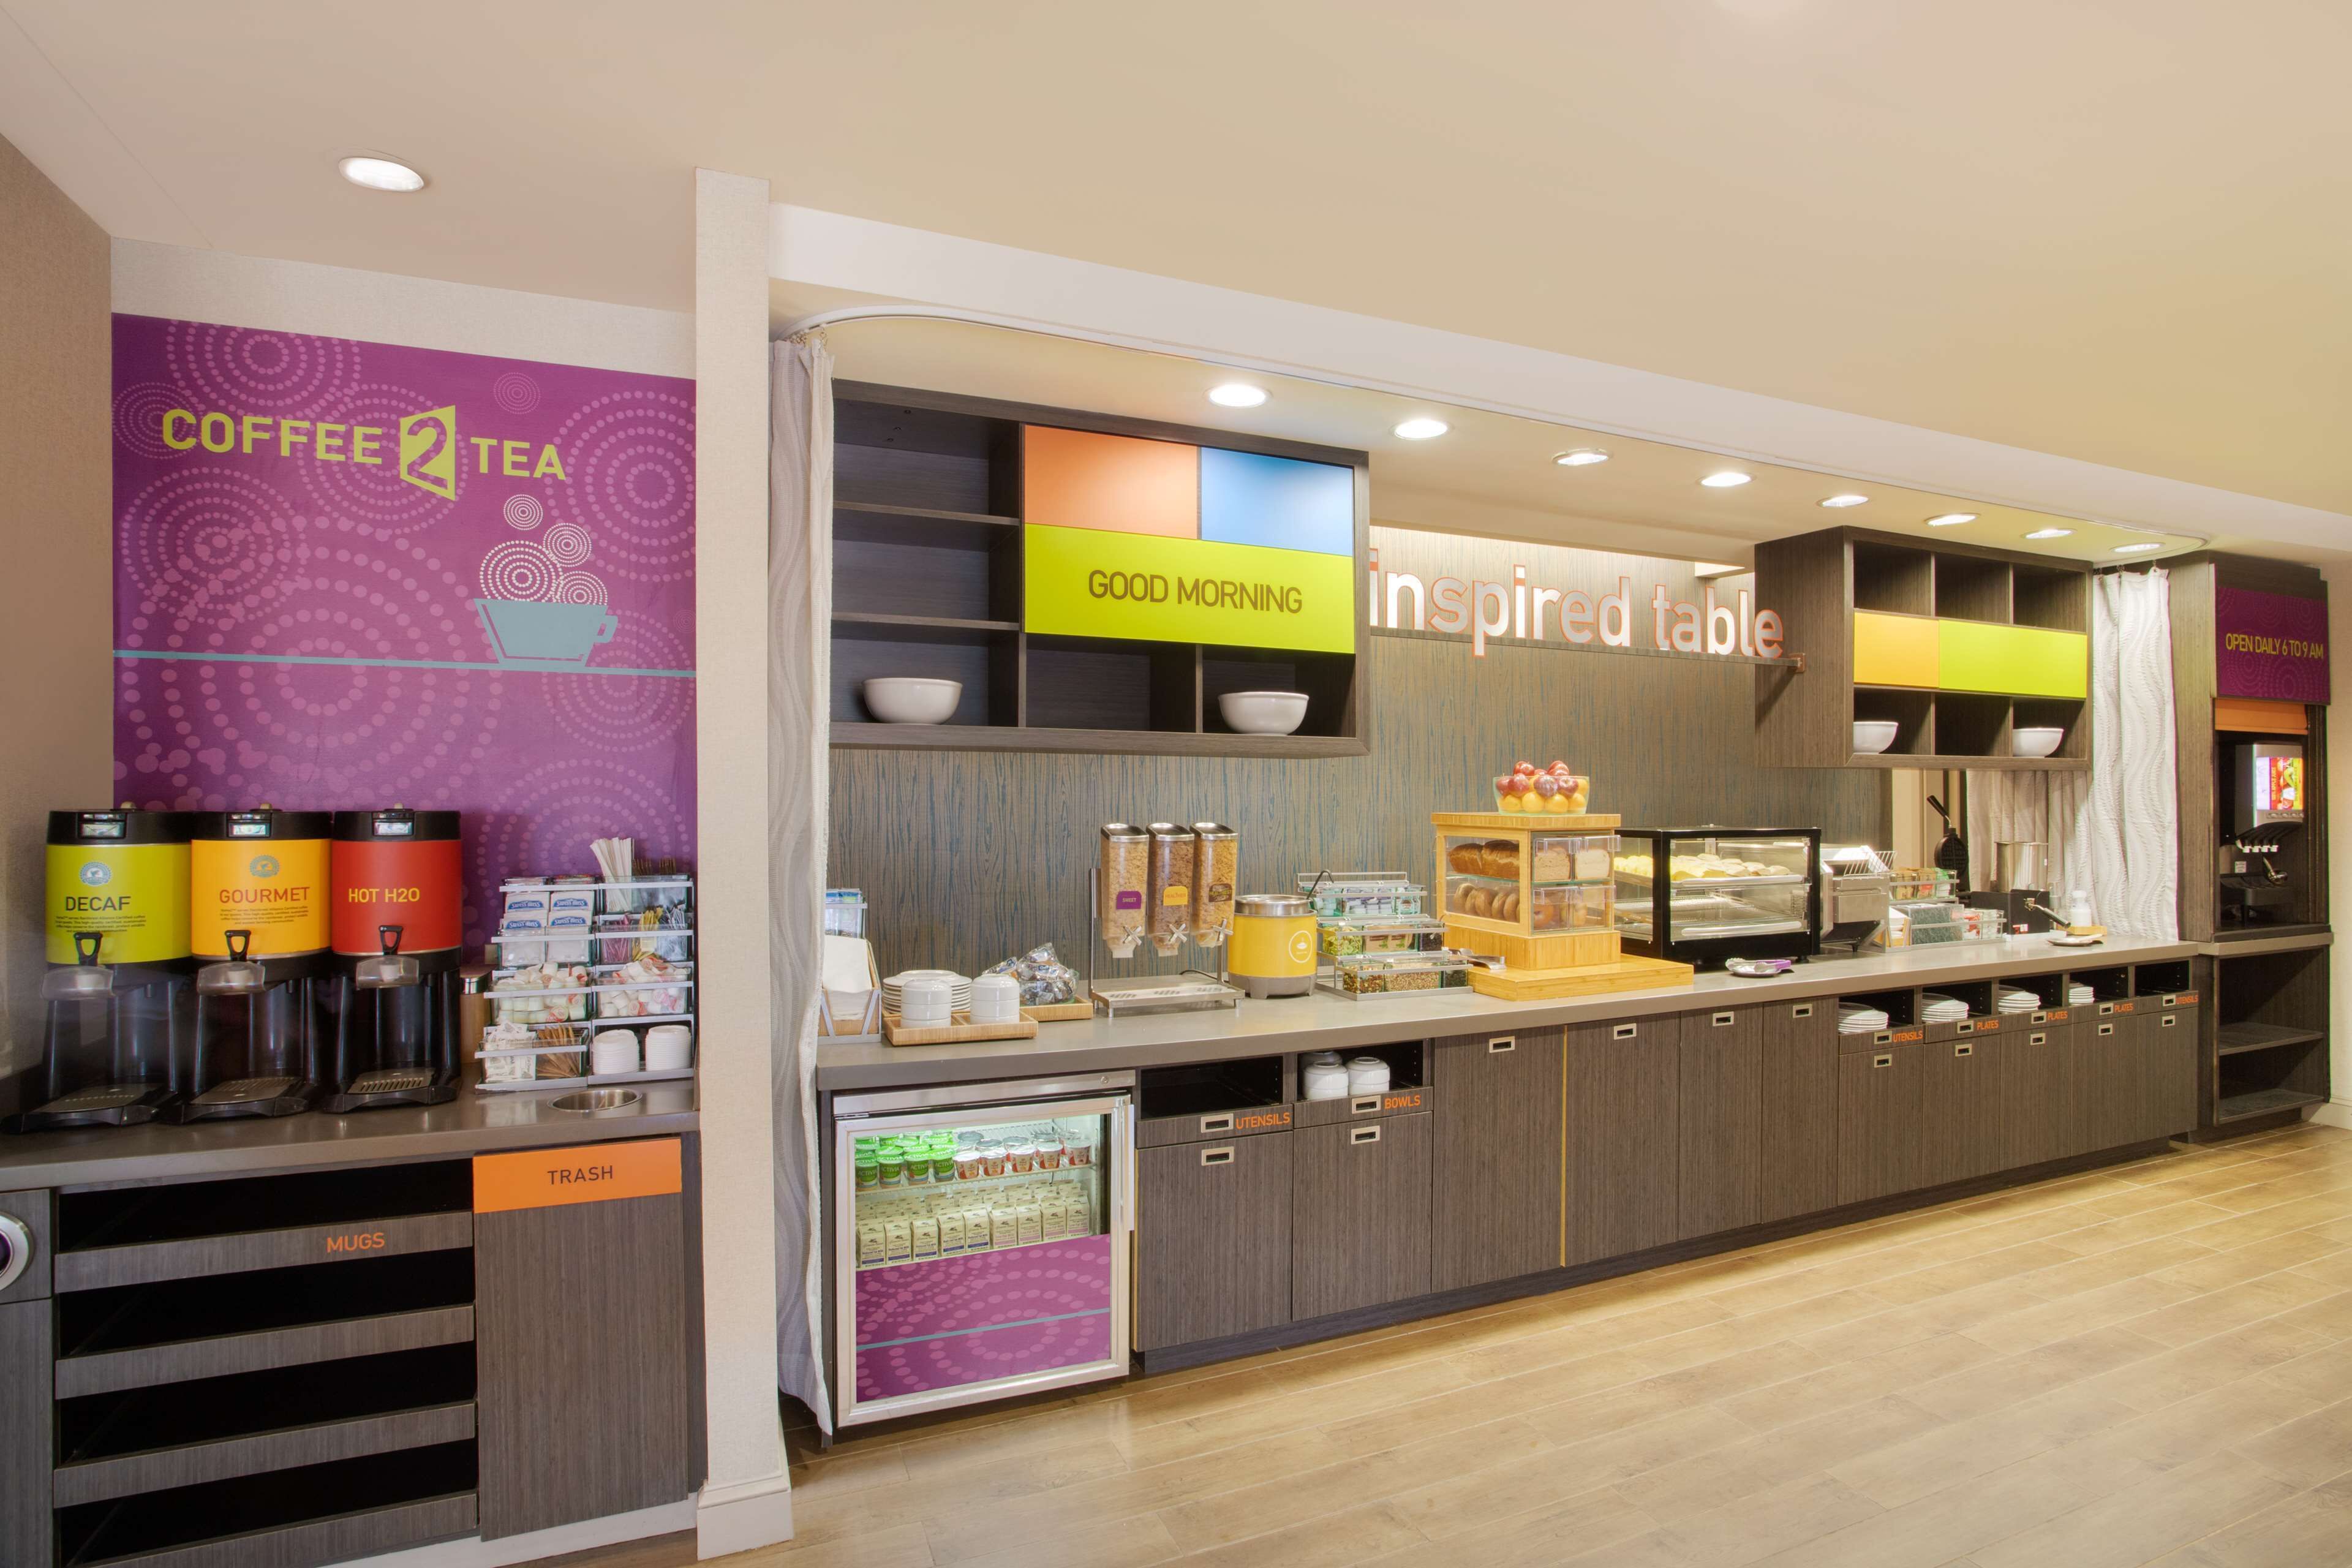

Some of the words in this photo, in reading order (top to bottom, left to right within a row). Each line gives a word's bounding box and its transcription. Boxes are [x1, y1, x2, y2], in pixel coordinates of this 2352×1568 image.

[162, 409, 382, 464] COFFEE
[470, 437, 566, 481] TEA
[1088, 569, 1169, 603] GOOD
[1177, 576, 1303, 614] MORNING
[1370, 548, 1630, 658] inspired
[1653, 584, 1783, 659] table
[2225, 633, 2253, 652] OPEN
[2255, 636, 2281, 655] DAILY
[2282, 639, 2288, 656] 6
[2288, 640, 2301, 657] TO
[2302, 641, 2308, 657] 9
[2309, 643, 2323, 659] AM
[219, 886, 311, 903] GOURMET
[349, 888, 380, 903] HOT
[385, 888, 420, 902] H2O
[66, 895, 131, 911] DECAF
[2114, 1003, 2133, 1012] PLATES
[2175, 995, 2198, 1005] UTENSILS
[2048, 1011, 2068, 1020] PLATES
[1977, 1020, 1999, 1030] PLATES
[1893, 1030, 1923, 1042] UTENSILS
[1384, 1095, 1420, 1109] BOWLS
[1235, 1112, 1291, 1130] UTENSILS
[548, 1164, 614, 1185] TRASH
[326, 1232, 385, 1254] MUGS
